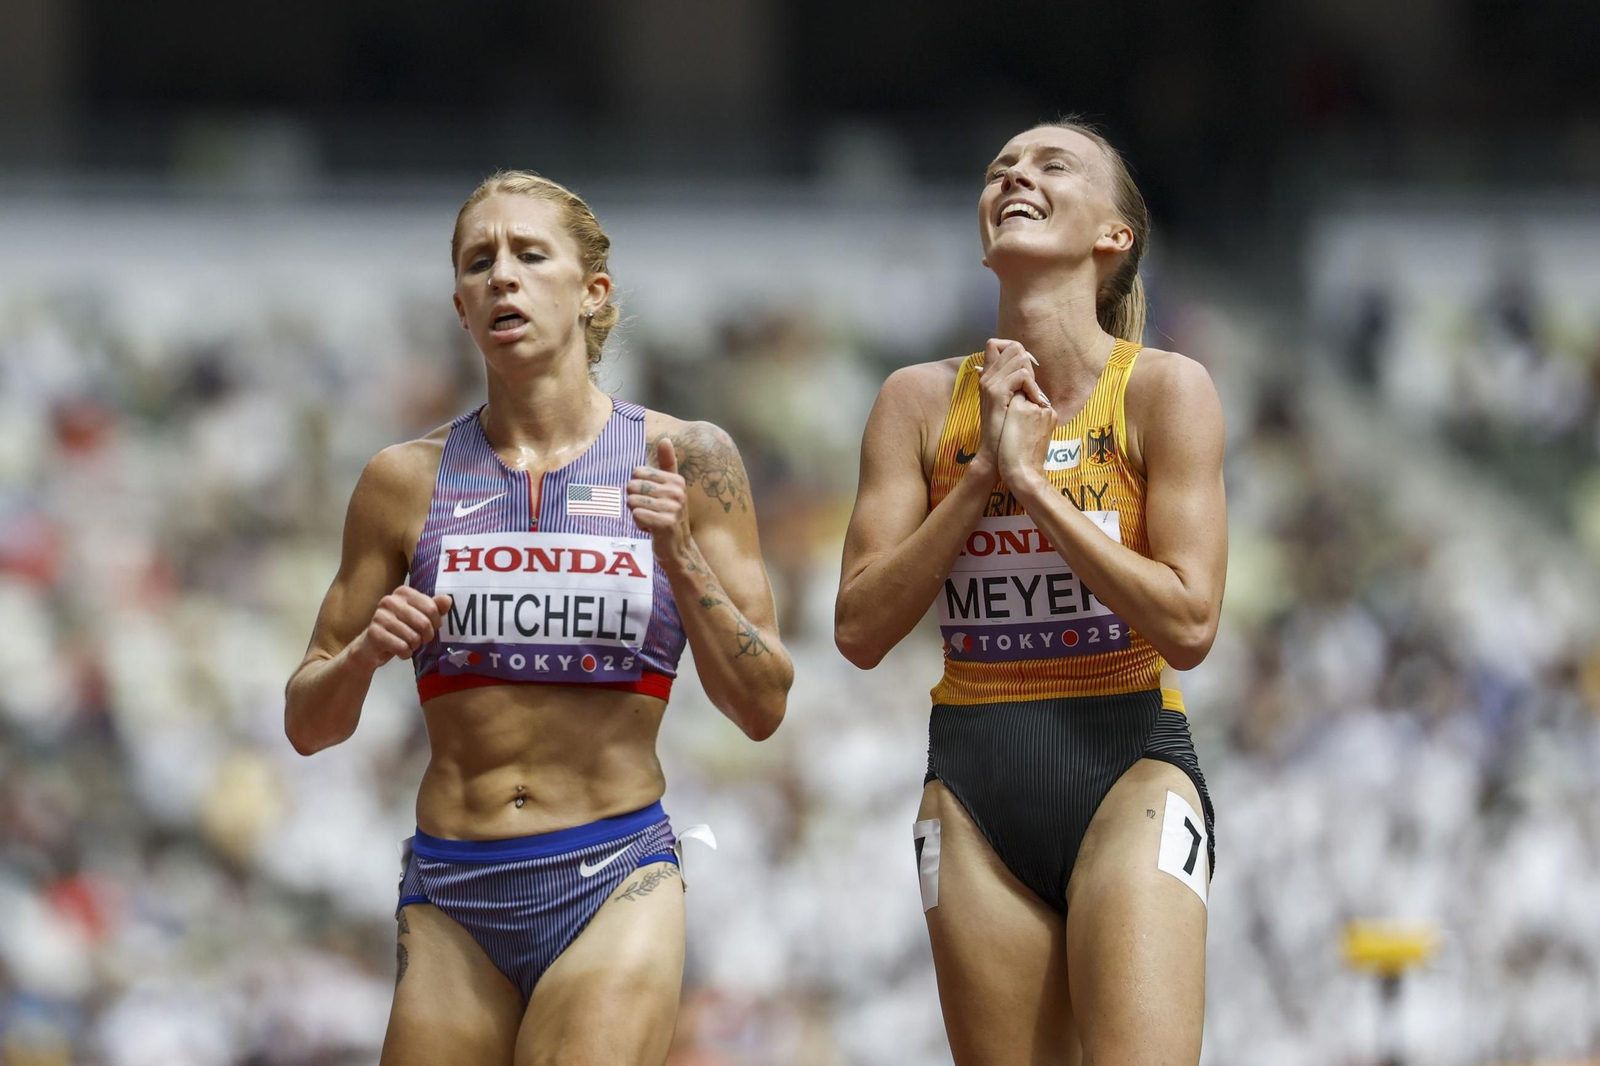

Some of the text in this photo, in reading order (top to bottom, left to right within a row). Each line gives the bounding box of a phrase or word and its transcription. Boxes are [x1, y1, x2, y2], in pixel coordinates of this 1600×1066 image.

[443, 546, 647, 578] HONDA
[447, 593, 636, 641] MITCHELL
[1087, 623, 1121, 643] 25
[603, 656, 635, 671] 25
[1183, 815, 1202, 876] 7
